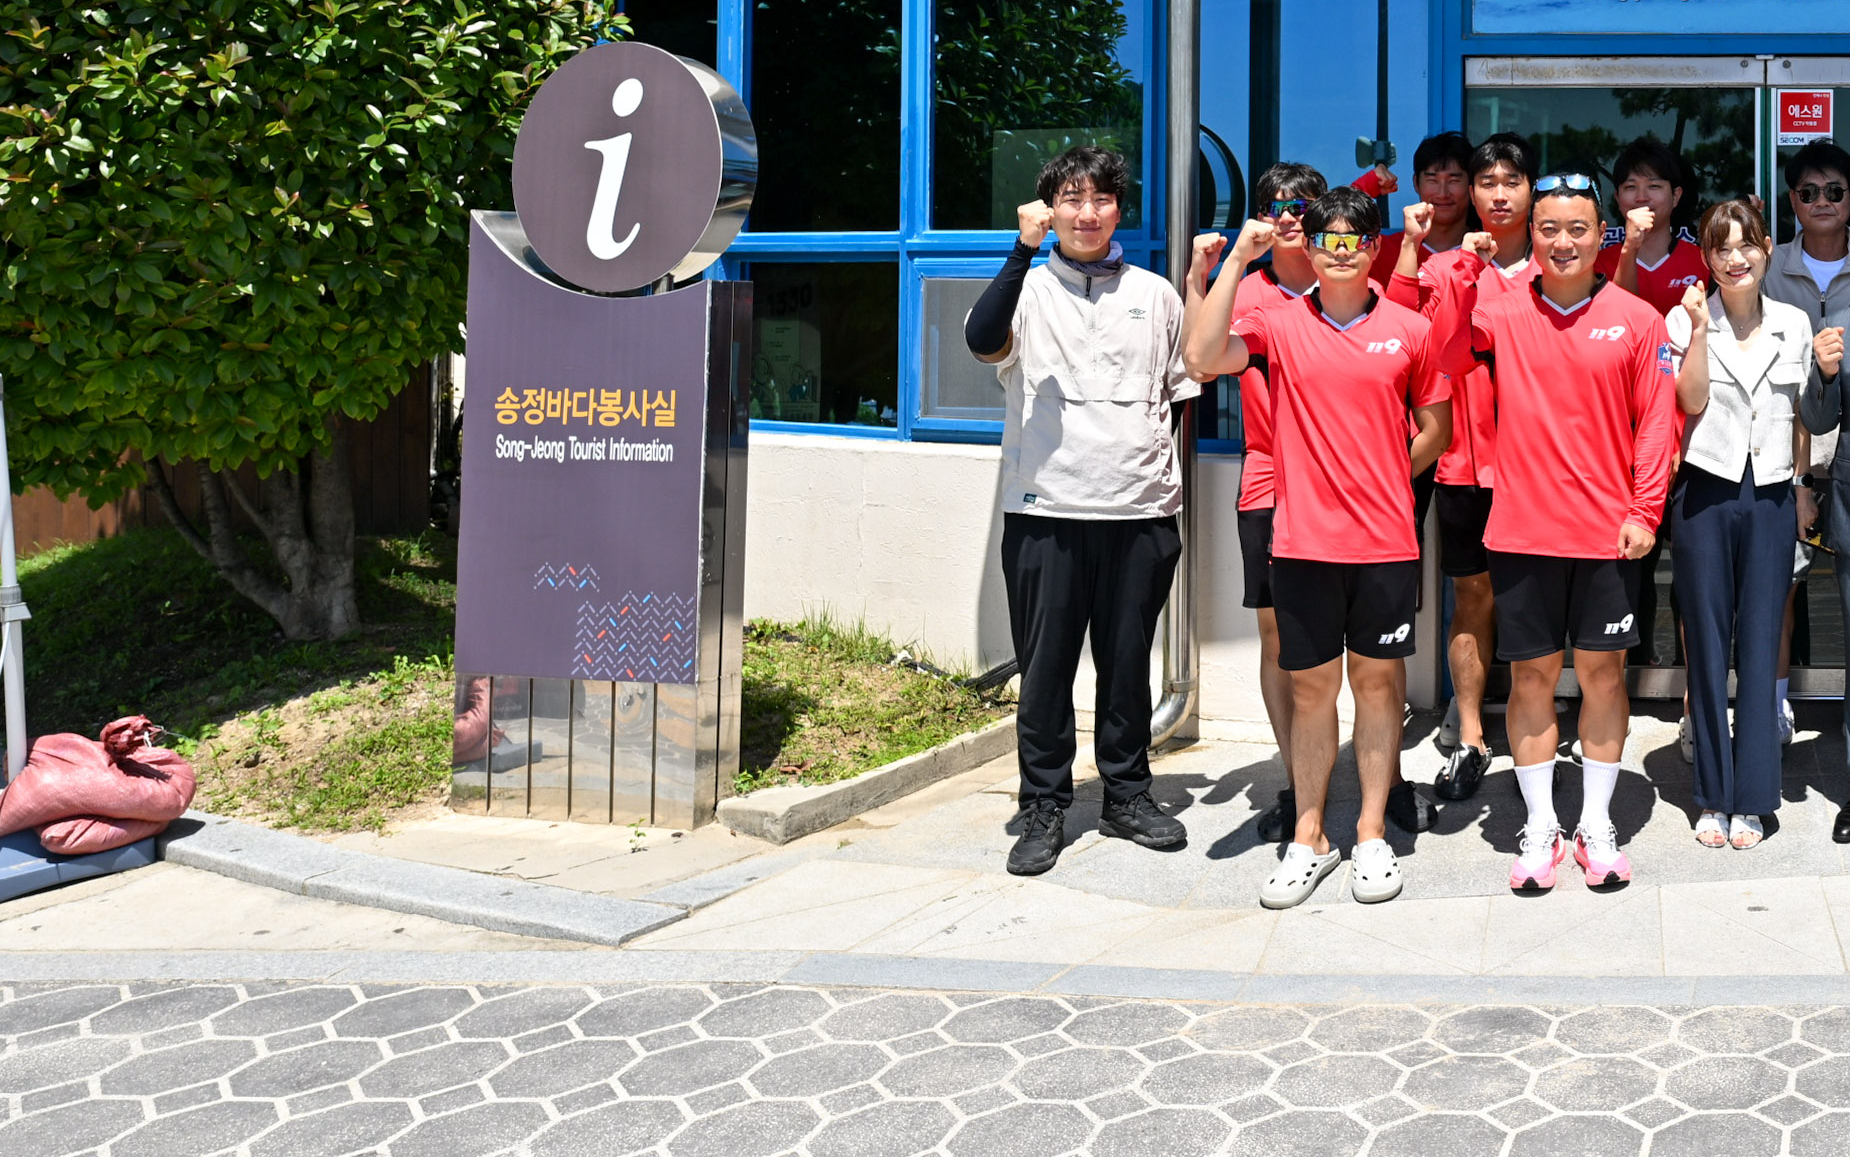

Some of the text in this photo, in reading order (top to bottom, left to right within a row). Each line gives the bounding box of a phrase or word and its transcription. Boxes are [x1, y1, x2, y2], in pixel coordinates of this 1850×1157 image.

[1788, 104, 1822, 118] 에스원
[1780, 136, 1804, 144] SECOM
[1669, 275, 1697, 288] 119
[1588, 325, 1626, 341] 119
[1366, 338, 1402, 355] 119
[495, 387, 676, 427] 송정바다봉사실
[496, 434, 674, 463] Song-Jeong Tourist Information
[1604, 613, 1634, 635] 119
[1379, 623, 1410, 645] 119
